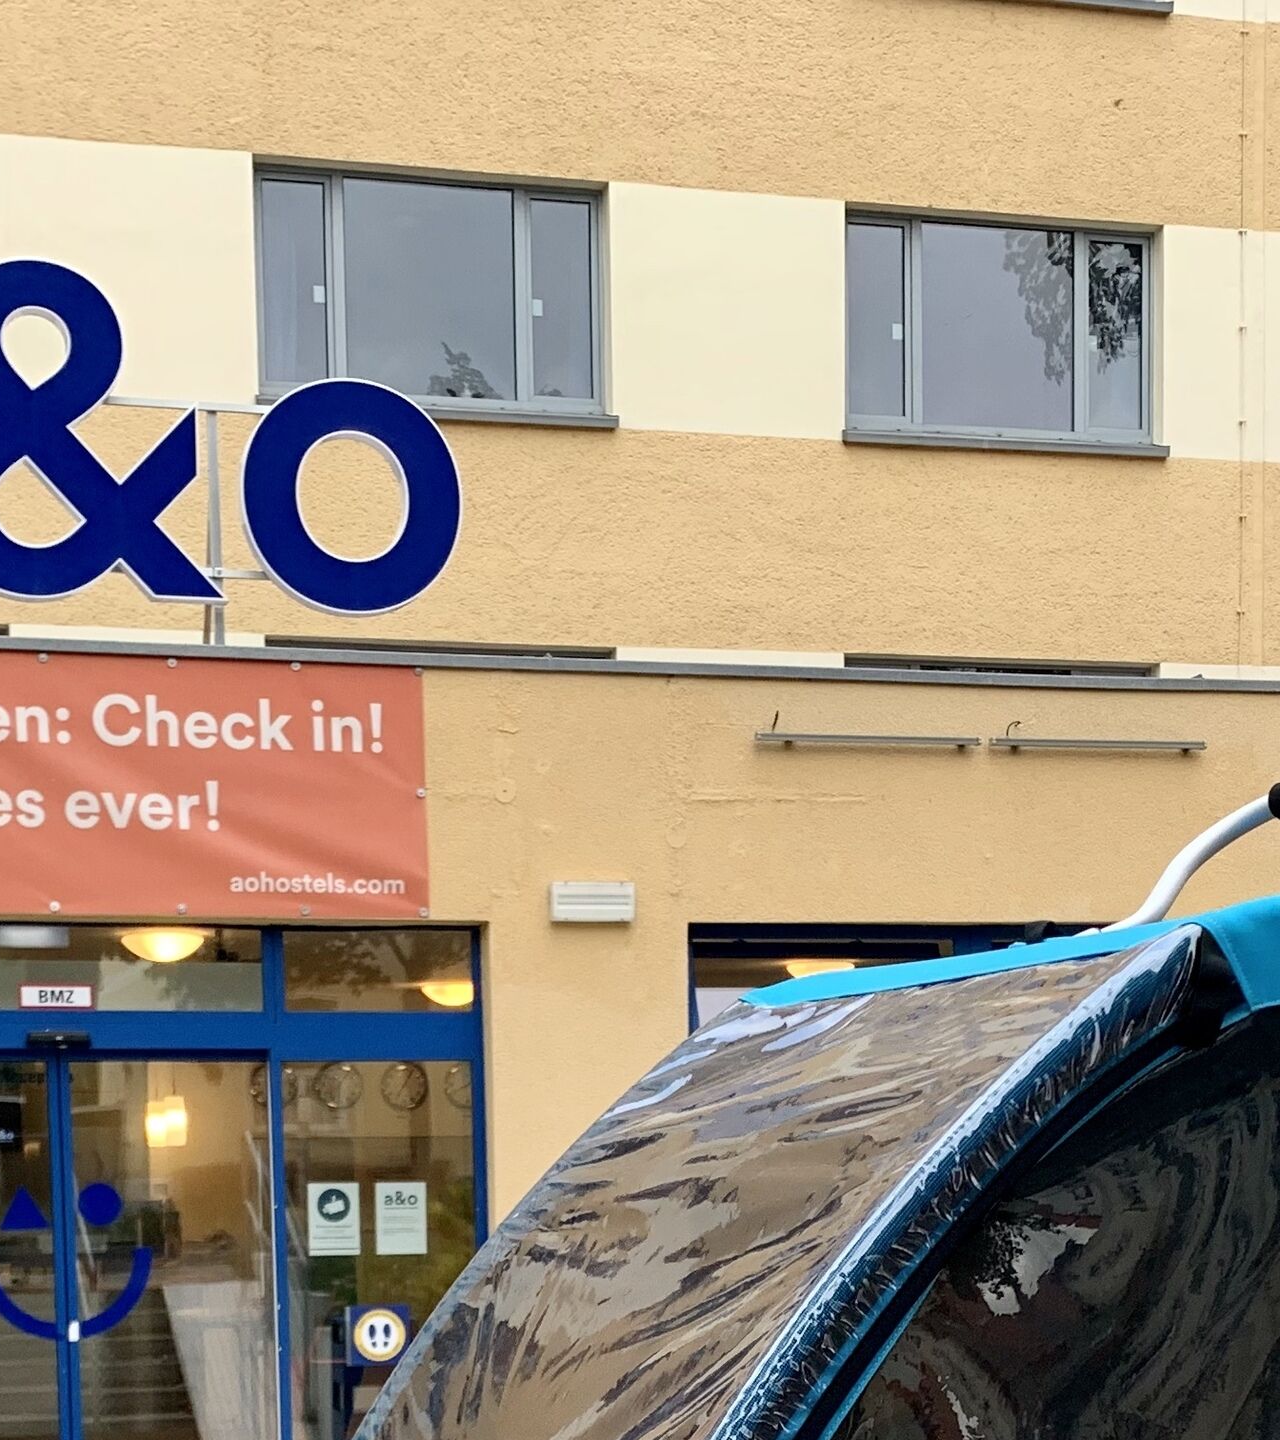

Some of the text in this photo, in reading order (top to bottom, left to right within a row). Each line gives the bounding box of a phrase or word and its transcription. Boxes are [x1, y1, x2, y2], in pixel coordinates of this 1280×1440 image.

[91, 692, 294, 752] Check
[311, 699, 384, 754] in!
[65, 780, 222, 832] ever!
[229, 871, 405, 895] aohostels.com
[38, 989, 75, 1005] BMZ
[384, 1191, 419, 1207] a&o
